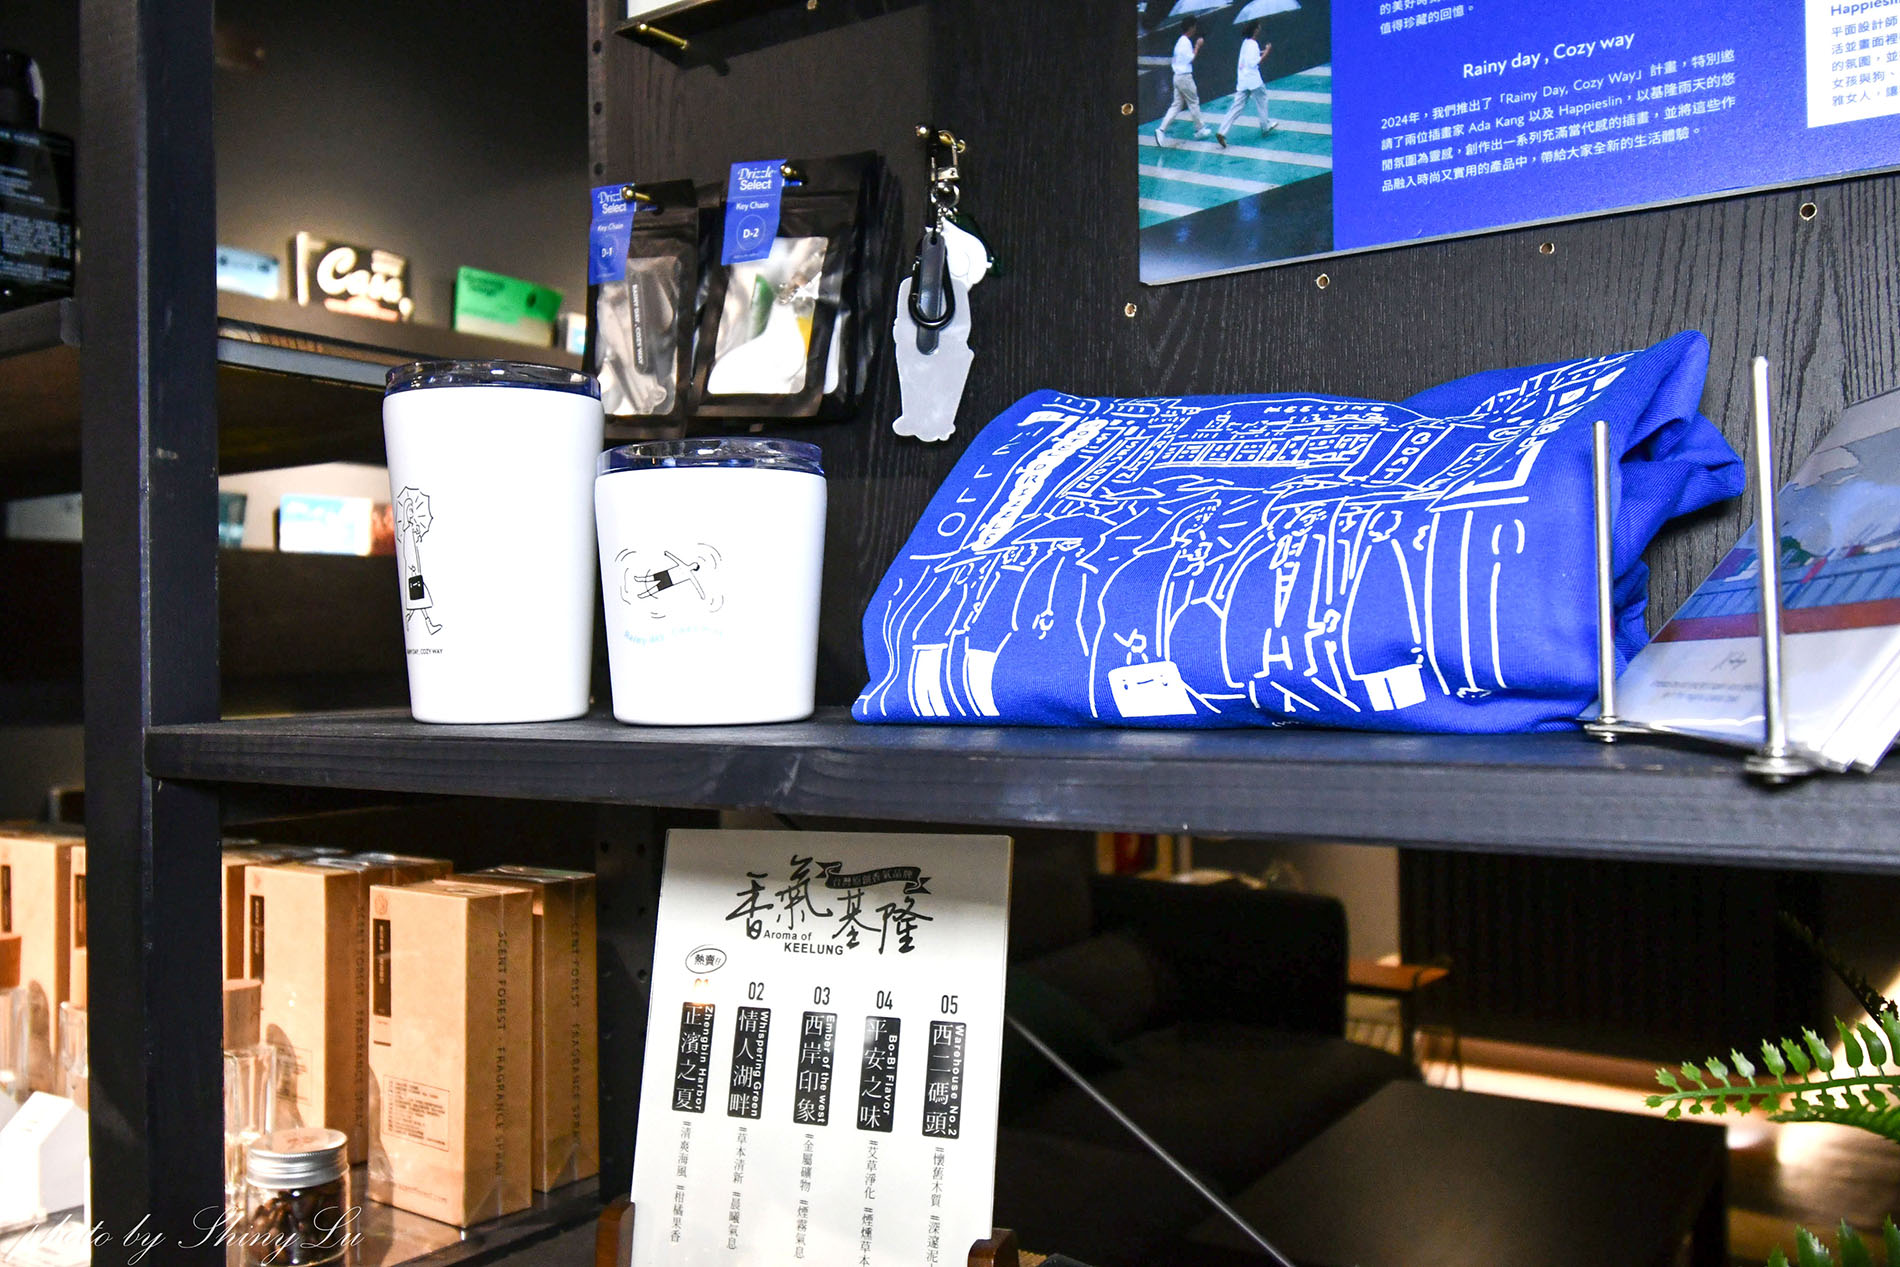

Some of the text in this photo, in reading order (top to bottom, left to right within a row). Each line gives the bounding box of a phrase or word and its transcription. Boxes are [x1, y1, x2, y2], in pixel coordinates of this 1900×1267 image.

[1463, 60, 1507, 79] Rainy
[1511, 52, 1541, 69] day
[1553, 41, 1597, 59] Cozy
[1600, 33, 1635, 49] way
[1542, 85, 1568, 97] Day,
[1573, 78, 1604, 91] Cozy
[1468, 121, 1491, 133] Ada
[1495, 115, 1525, 129] Kang
[1528, 106, 1554, 122] 以及
[737, 165, 776, 181] Drizzle
[740, 179, 773, 191] Select
[601, 203, 627, 214] Select
[736, 201, 769, 212] Key Chain
[597, 222, 624, 232] Key Chain
[743, 228, 760, 239] D-2
[601, 247, 613, 258] D-1
[764, 930, 813, 941] Aroma of
[498, 931, 508, 974] SCENT
[784, 942, 844, 956] KEELUNG
[748, 982, 765, 1001] 02
[814, 986, 831, 1005] 03
[876, 990, 893, 1010] 04
[497, 980, 507, 1031] FOREST
[941, 995, 958, 1014] 05
[700, 1006, 714, 1063] Zhengbin
[824, 1015, 835, 1053] Ember
[675, 1006, 702, 1110] 正濱之夏
[729, 1009, 759, 1116] 情人湖畔
[750, 1011, 769, 1117] Whispering Green
[796, 1015, 824, 1122] 西岸印象
[822, 1057, 831, 1069] of
[820, 1072, 830, 1091] the
[860, 1019, 888, 1128] 平安之味
[925, 1024, 953, 1135] 西二碼頭
[948, 1025, 965, 1136] Warehouse No.2
[495, 1047, 507, 1129] FRAGRANCE
[694, 1068, 707, 1110] Harbor
[883, 1075, 895, 1116] Flavor
